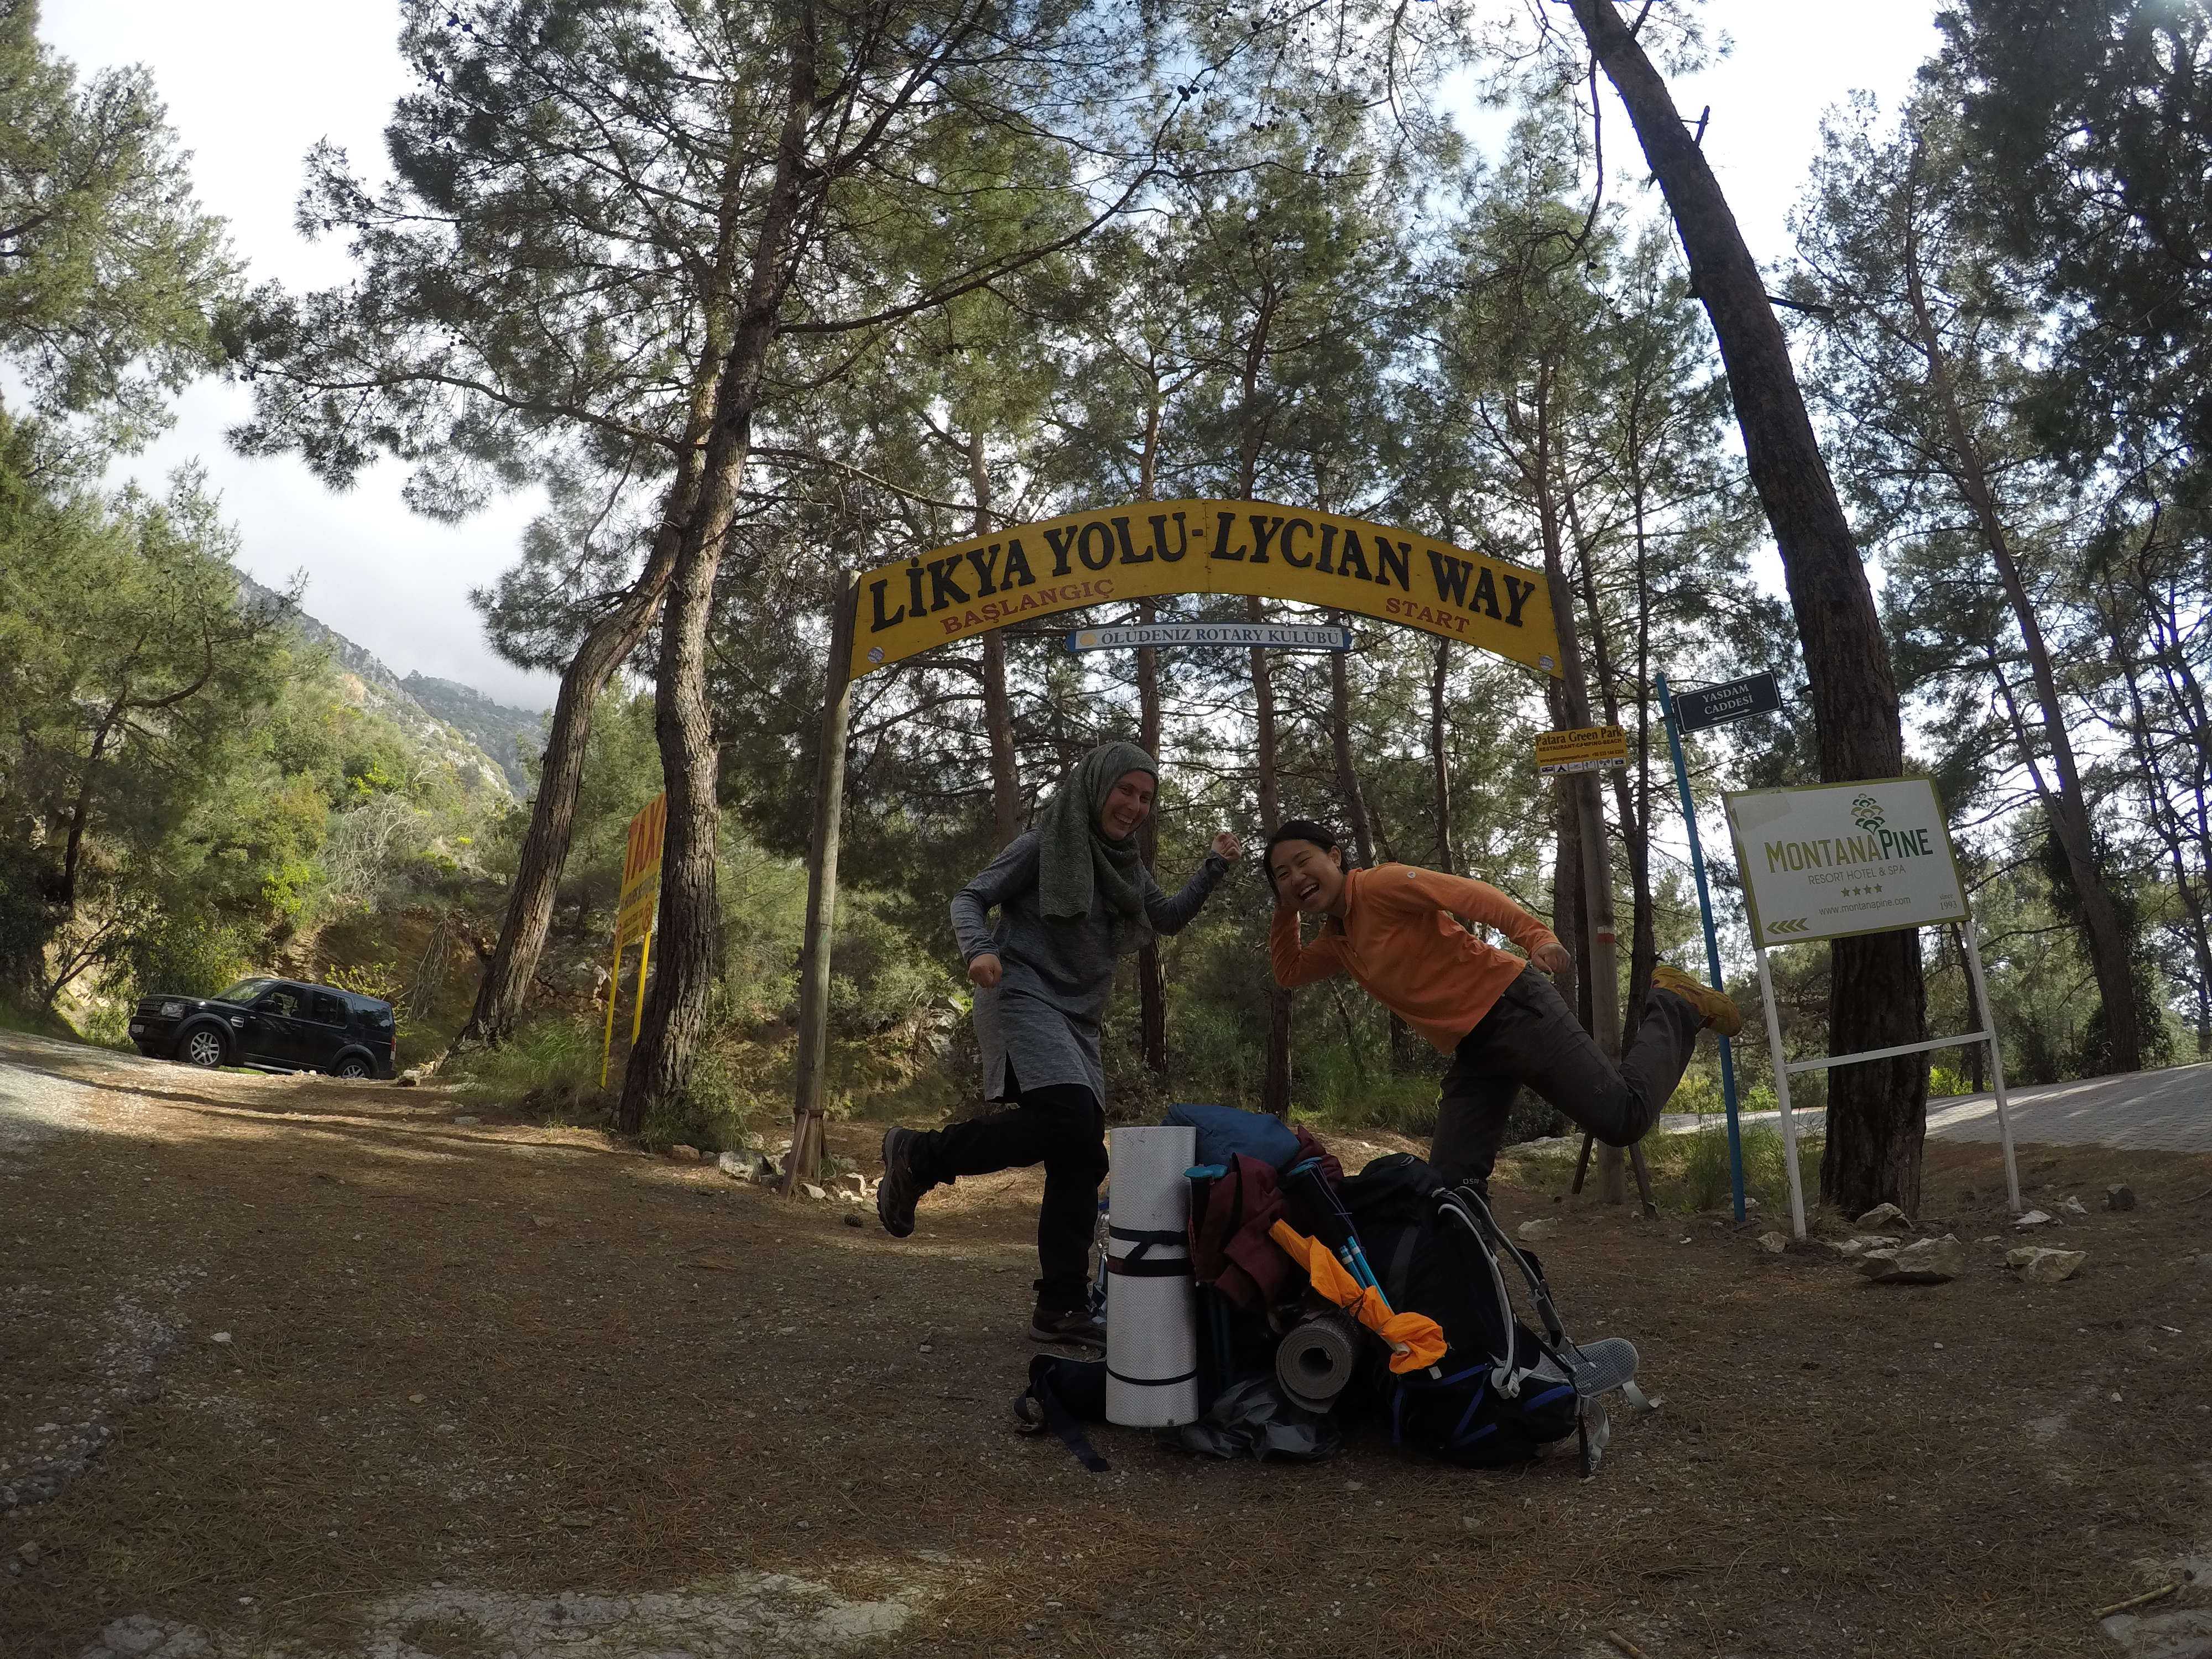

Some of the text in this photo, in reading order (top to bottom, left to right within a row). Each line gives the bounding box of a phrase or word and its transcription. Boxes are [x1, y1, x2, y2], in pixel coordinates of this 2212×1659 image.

[869, 539, 1036, 633] LİKYA
[1427, 549, 1536, 627] WAY
[940, 579, 1470, 635] BAŞLANGIÇ START
[1101, 625, 1341, 644] ÖLÜDENİZ ROTARY KULÜBÜ
[1702, 684, 1750, 703] YASDAM
[1704, 693, 1754, 714] CADDESİ
[1535, 726, 1623, 746] Patara Green Park
[1808, 864, 1906, 885] RESORT HOTEL & SPA
[1819, 896, 1911, 916] www.montanapine.com
[1940, 900, 1957, 910] 1993
